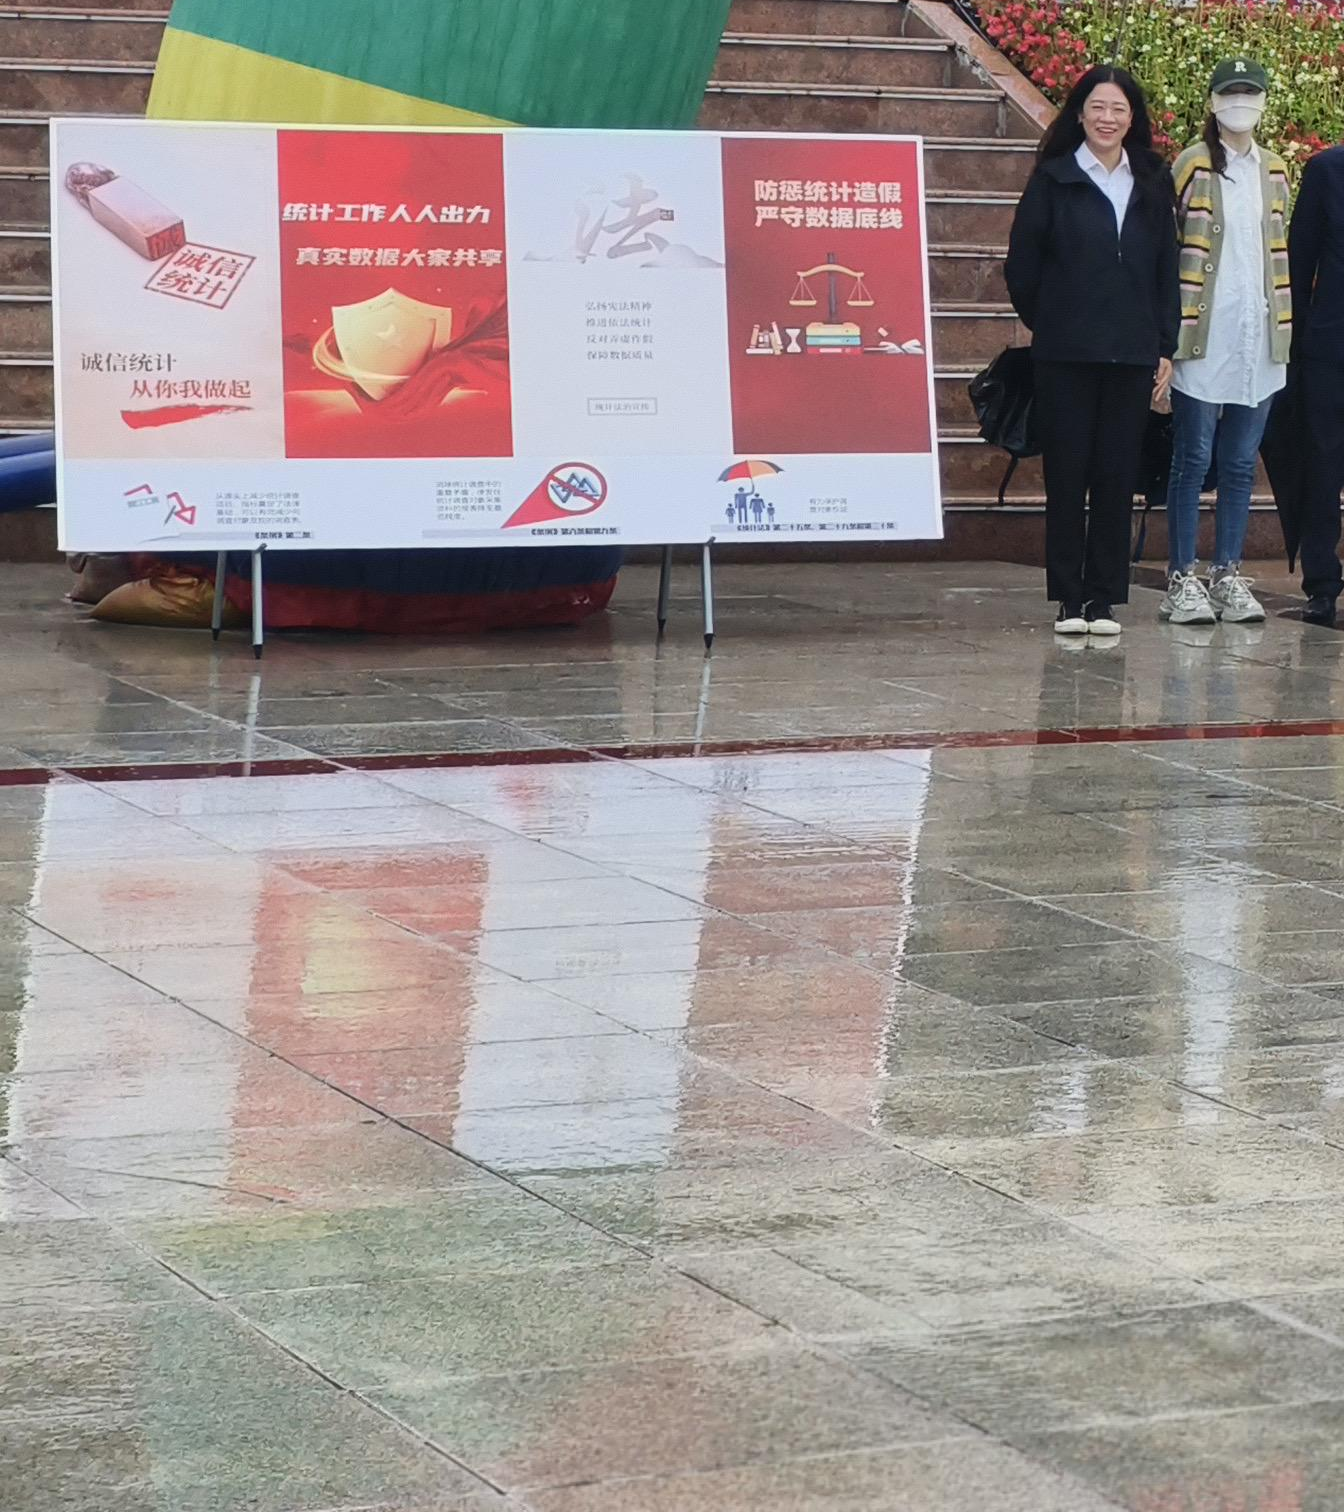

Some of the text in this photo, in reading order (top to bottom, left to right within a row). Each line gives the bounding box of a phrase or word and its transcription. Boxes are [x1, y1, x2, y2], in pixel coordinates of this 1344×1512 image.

[1234, 61, 1247, 72] R
[754, 180, 903, 203] 防惩统计造假
[282, 202, 492, 224] 统计工作人人出力
[755, 205, 903, 229] 严守数据底线
[296, 246, 503, 267] 真实数据大家共享
[157, 270, 227, 300] 统计
[81, 352, 177, 373] 诚信统计
[130, 379, 251, 399] 从你我做起
